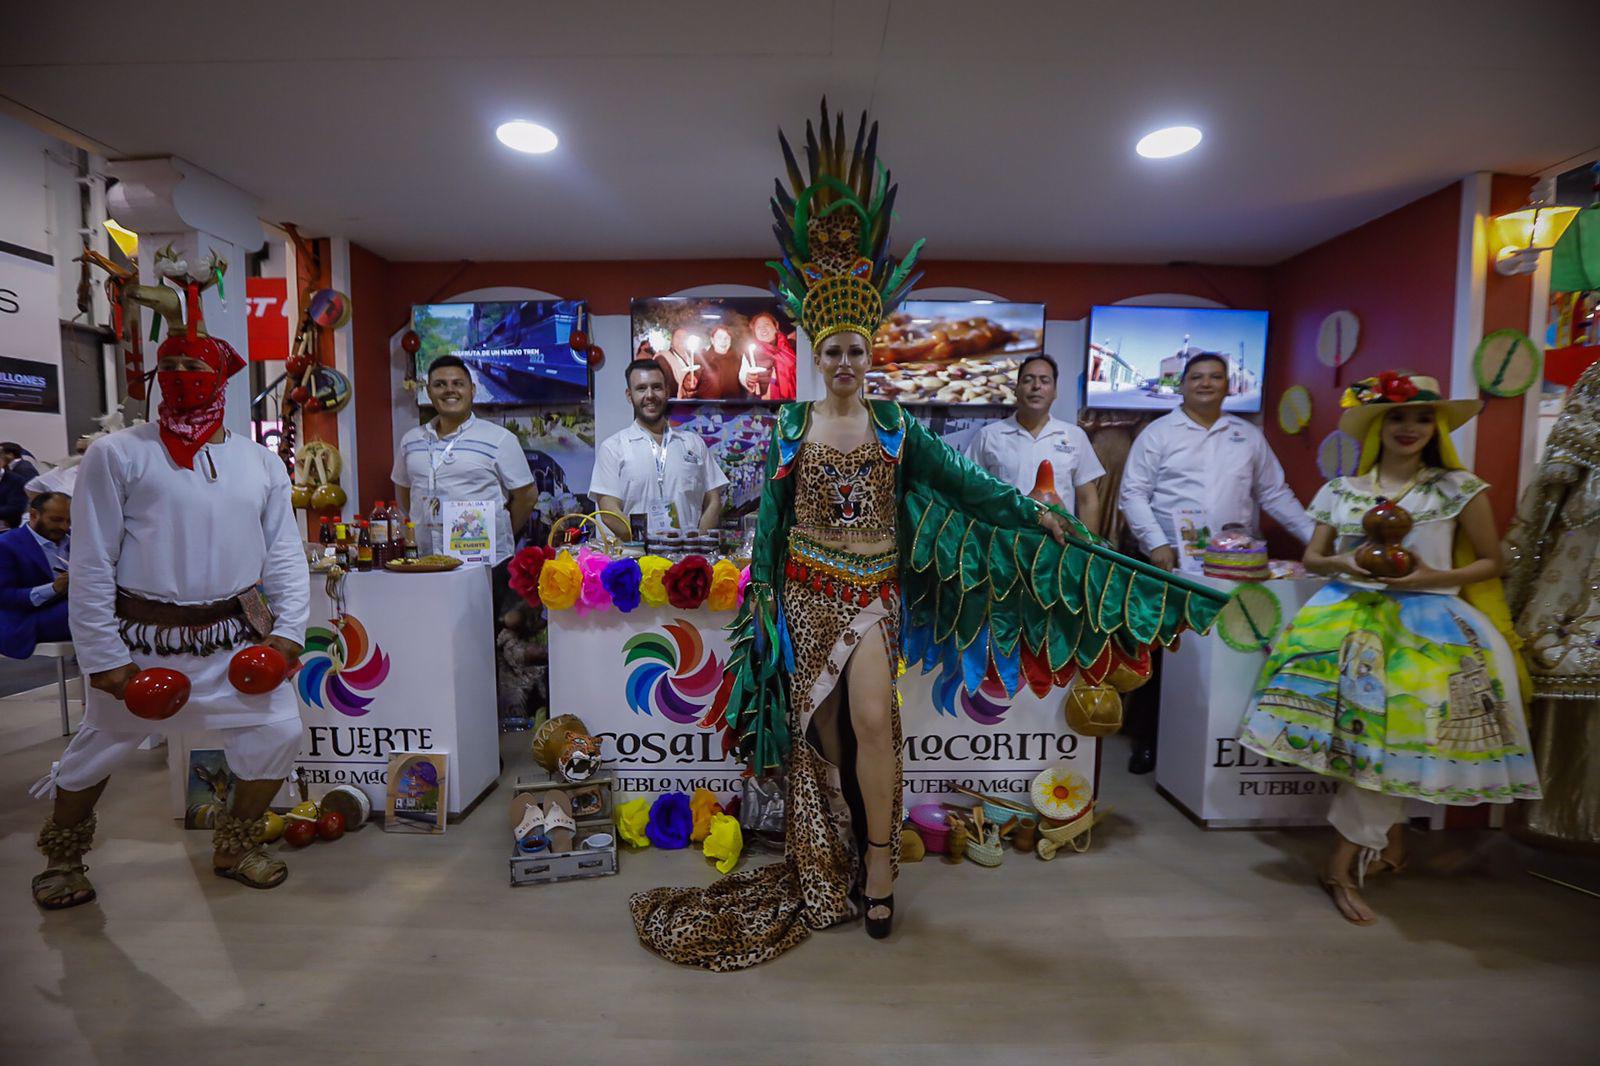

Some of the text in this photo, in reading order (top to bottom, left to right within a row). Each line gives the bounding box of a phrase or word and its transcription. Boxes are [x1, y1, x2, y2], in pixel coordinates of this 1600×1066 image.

[309, 726, 433, 757] FUERTE
[594, 731, 748, 764] COSAL
[1213, 737, 1260, 767] EL
[1239, 780, 1316, 796] PUEBLO
